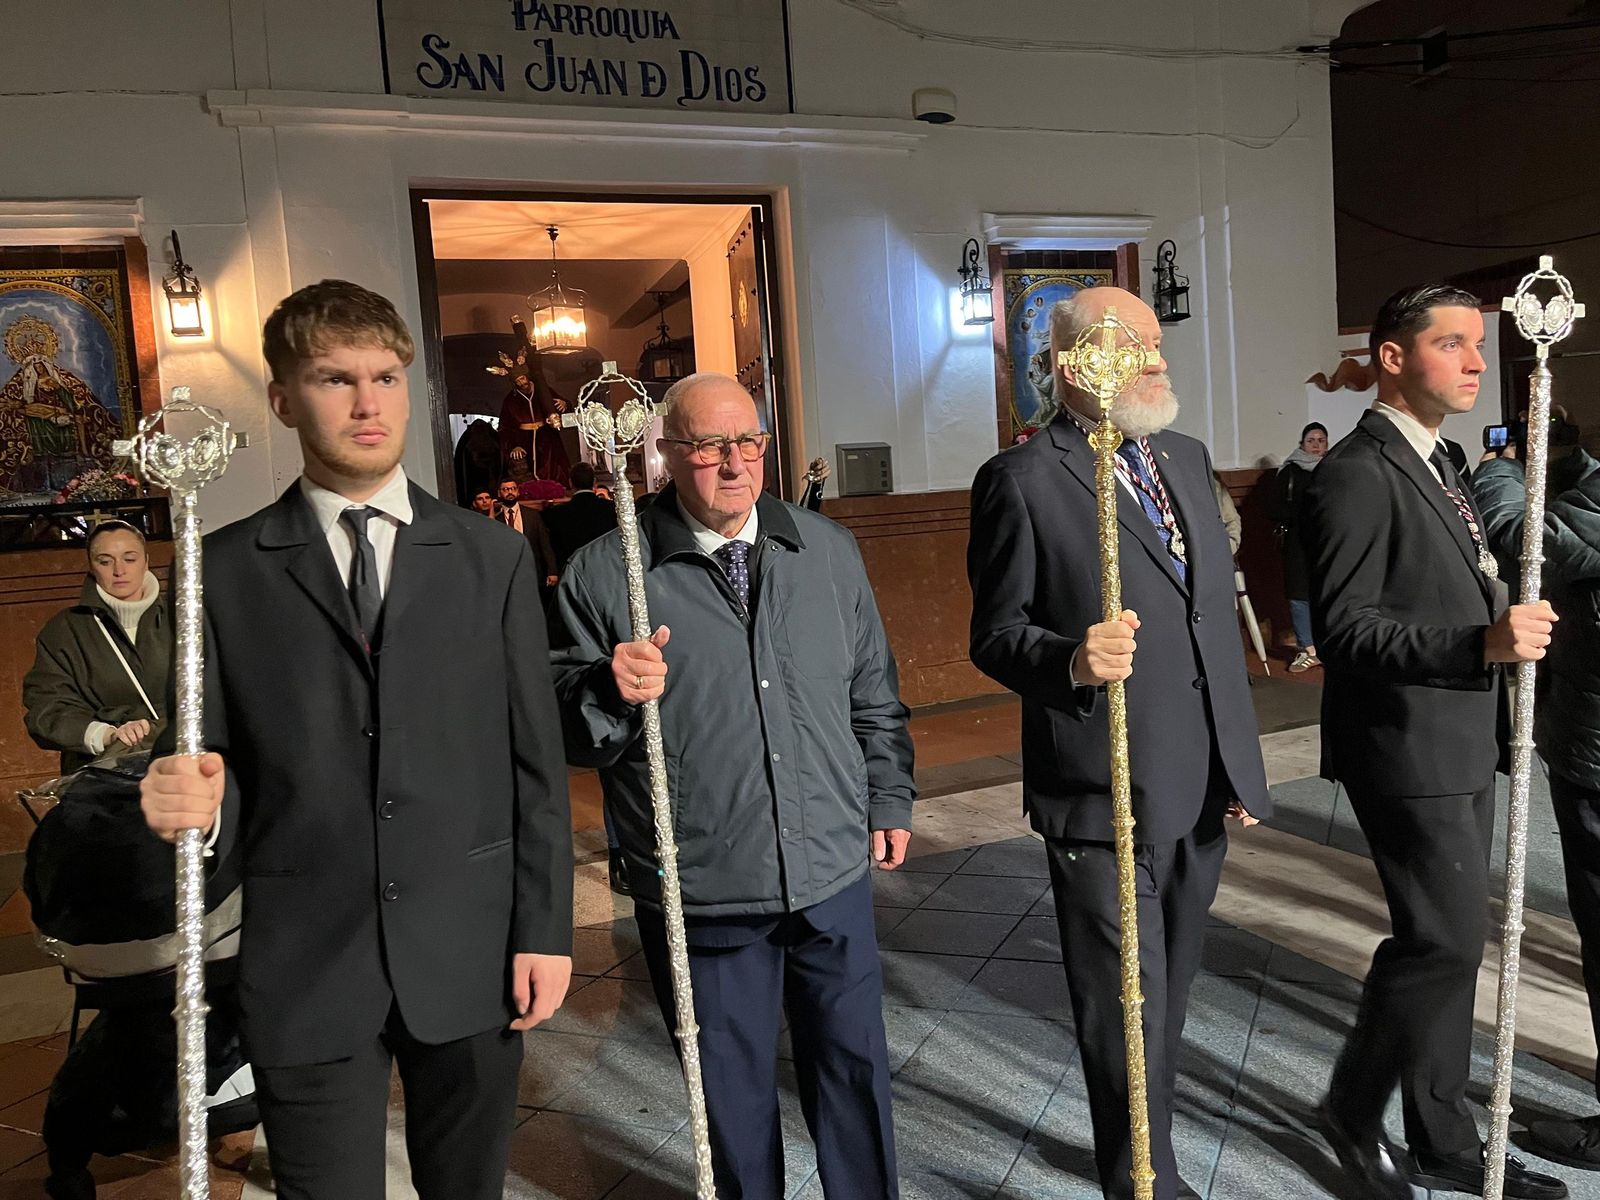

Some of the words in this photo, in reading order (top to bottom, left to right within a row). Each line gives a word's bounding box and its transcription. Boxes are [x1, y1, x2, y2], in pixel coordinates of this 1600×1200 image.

[509, 0, 681, 43] PARROQUIA
[416, 33, 505, 92] SAN
[524, 37, 629, 96] JUAN
[676, 49, 767, 107] DIOS
